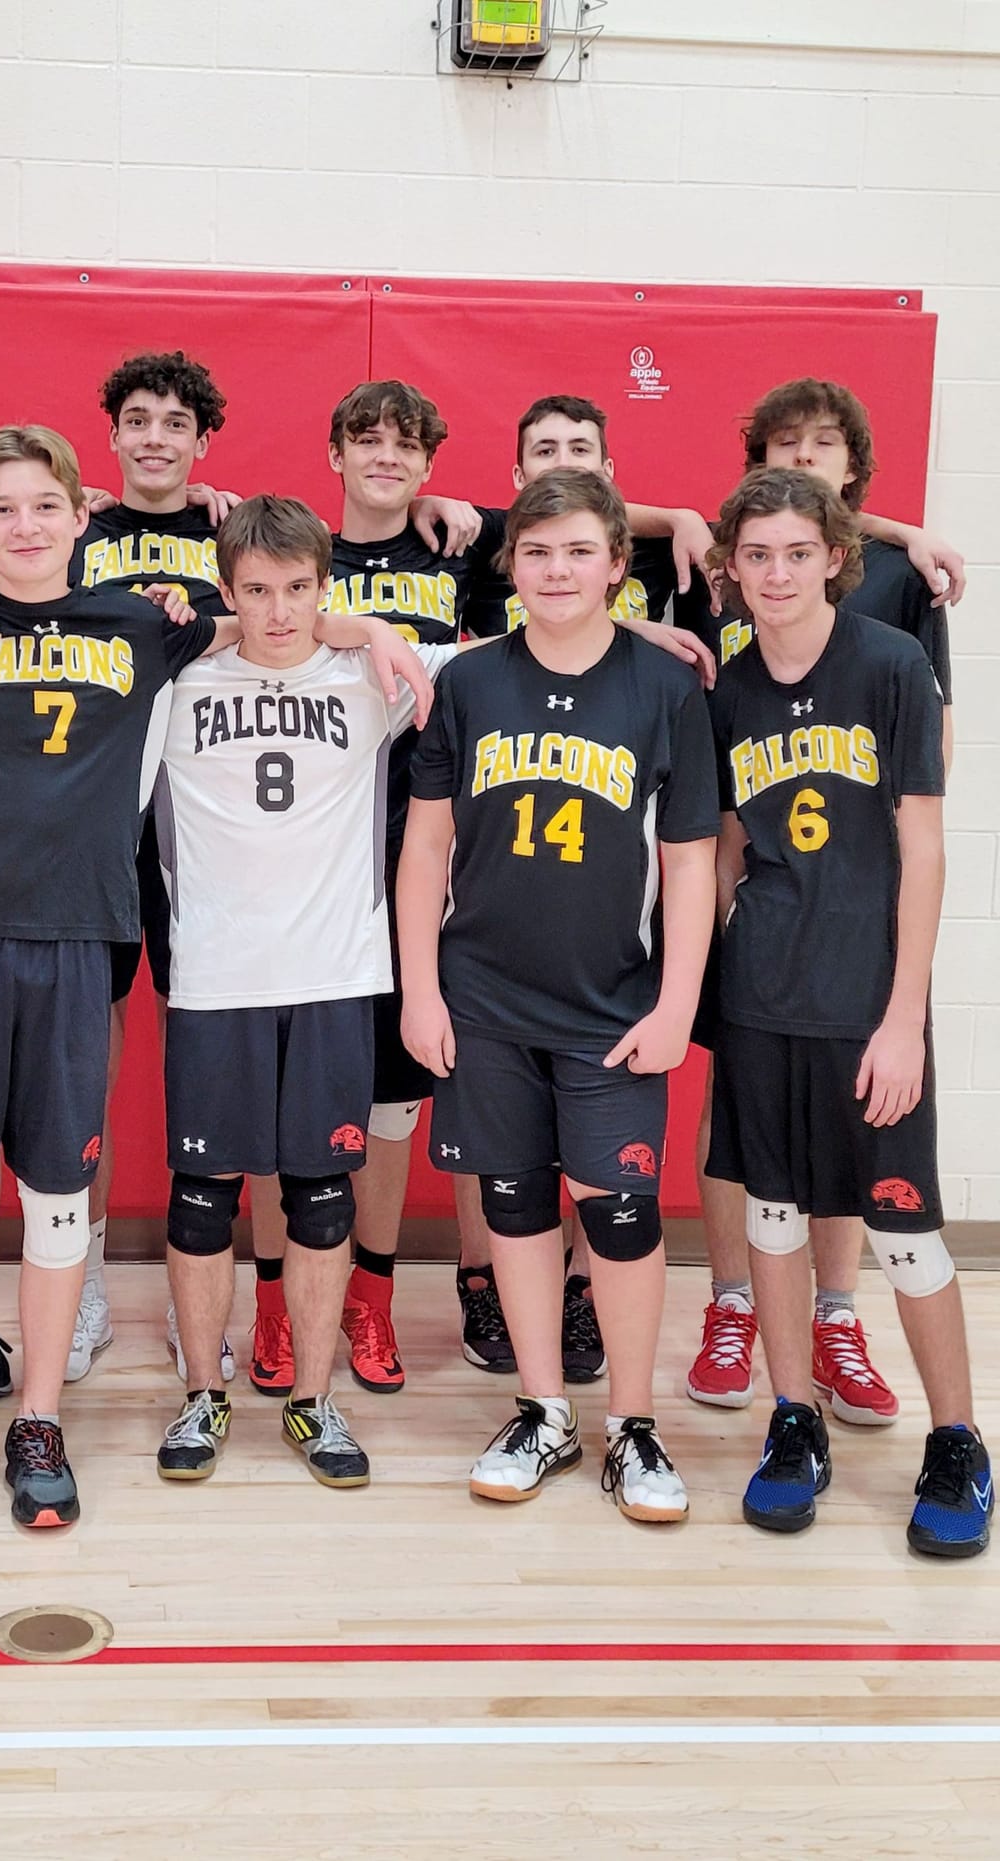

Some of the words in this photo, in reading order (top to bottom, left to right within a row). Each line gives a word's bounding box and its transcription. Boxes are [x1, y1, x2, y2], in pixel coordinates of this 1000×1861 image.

[630, 367, 662, 379] apple
[33, 690, 77, 754] 7
[192, 694, 349, 755] FALCONS
[255, 751, 295, 812] 8
[471, 729, 637, 812] FALCONS
[729, 723, 881, 809] FALCONS
[512, 793, 585, 863] 14
[788, 788, 831, 853] 6
[181, 1193, 213, 1208] DIADORA
[310, 1190, 344, 1203] DIADORA
